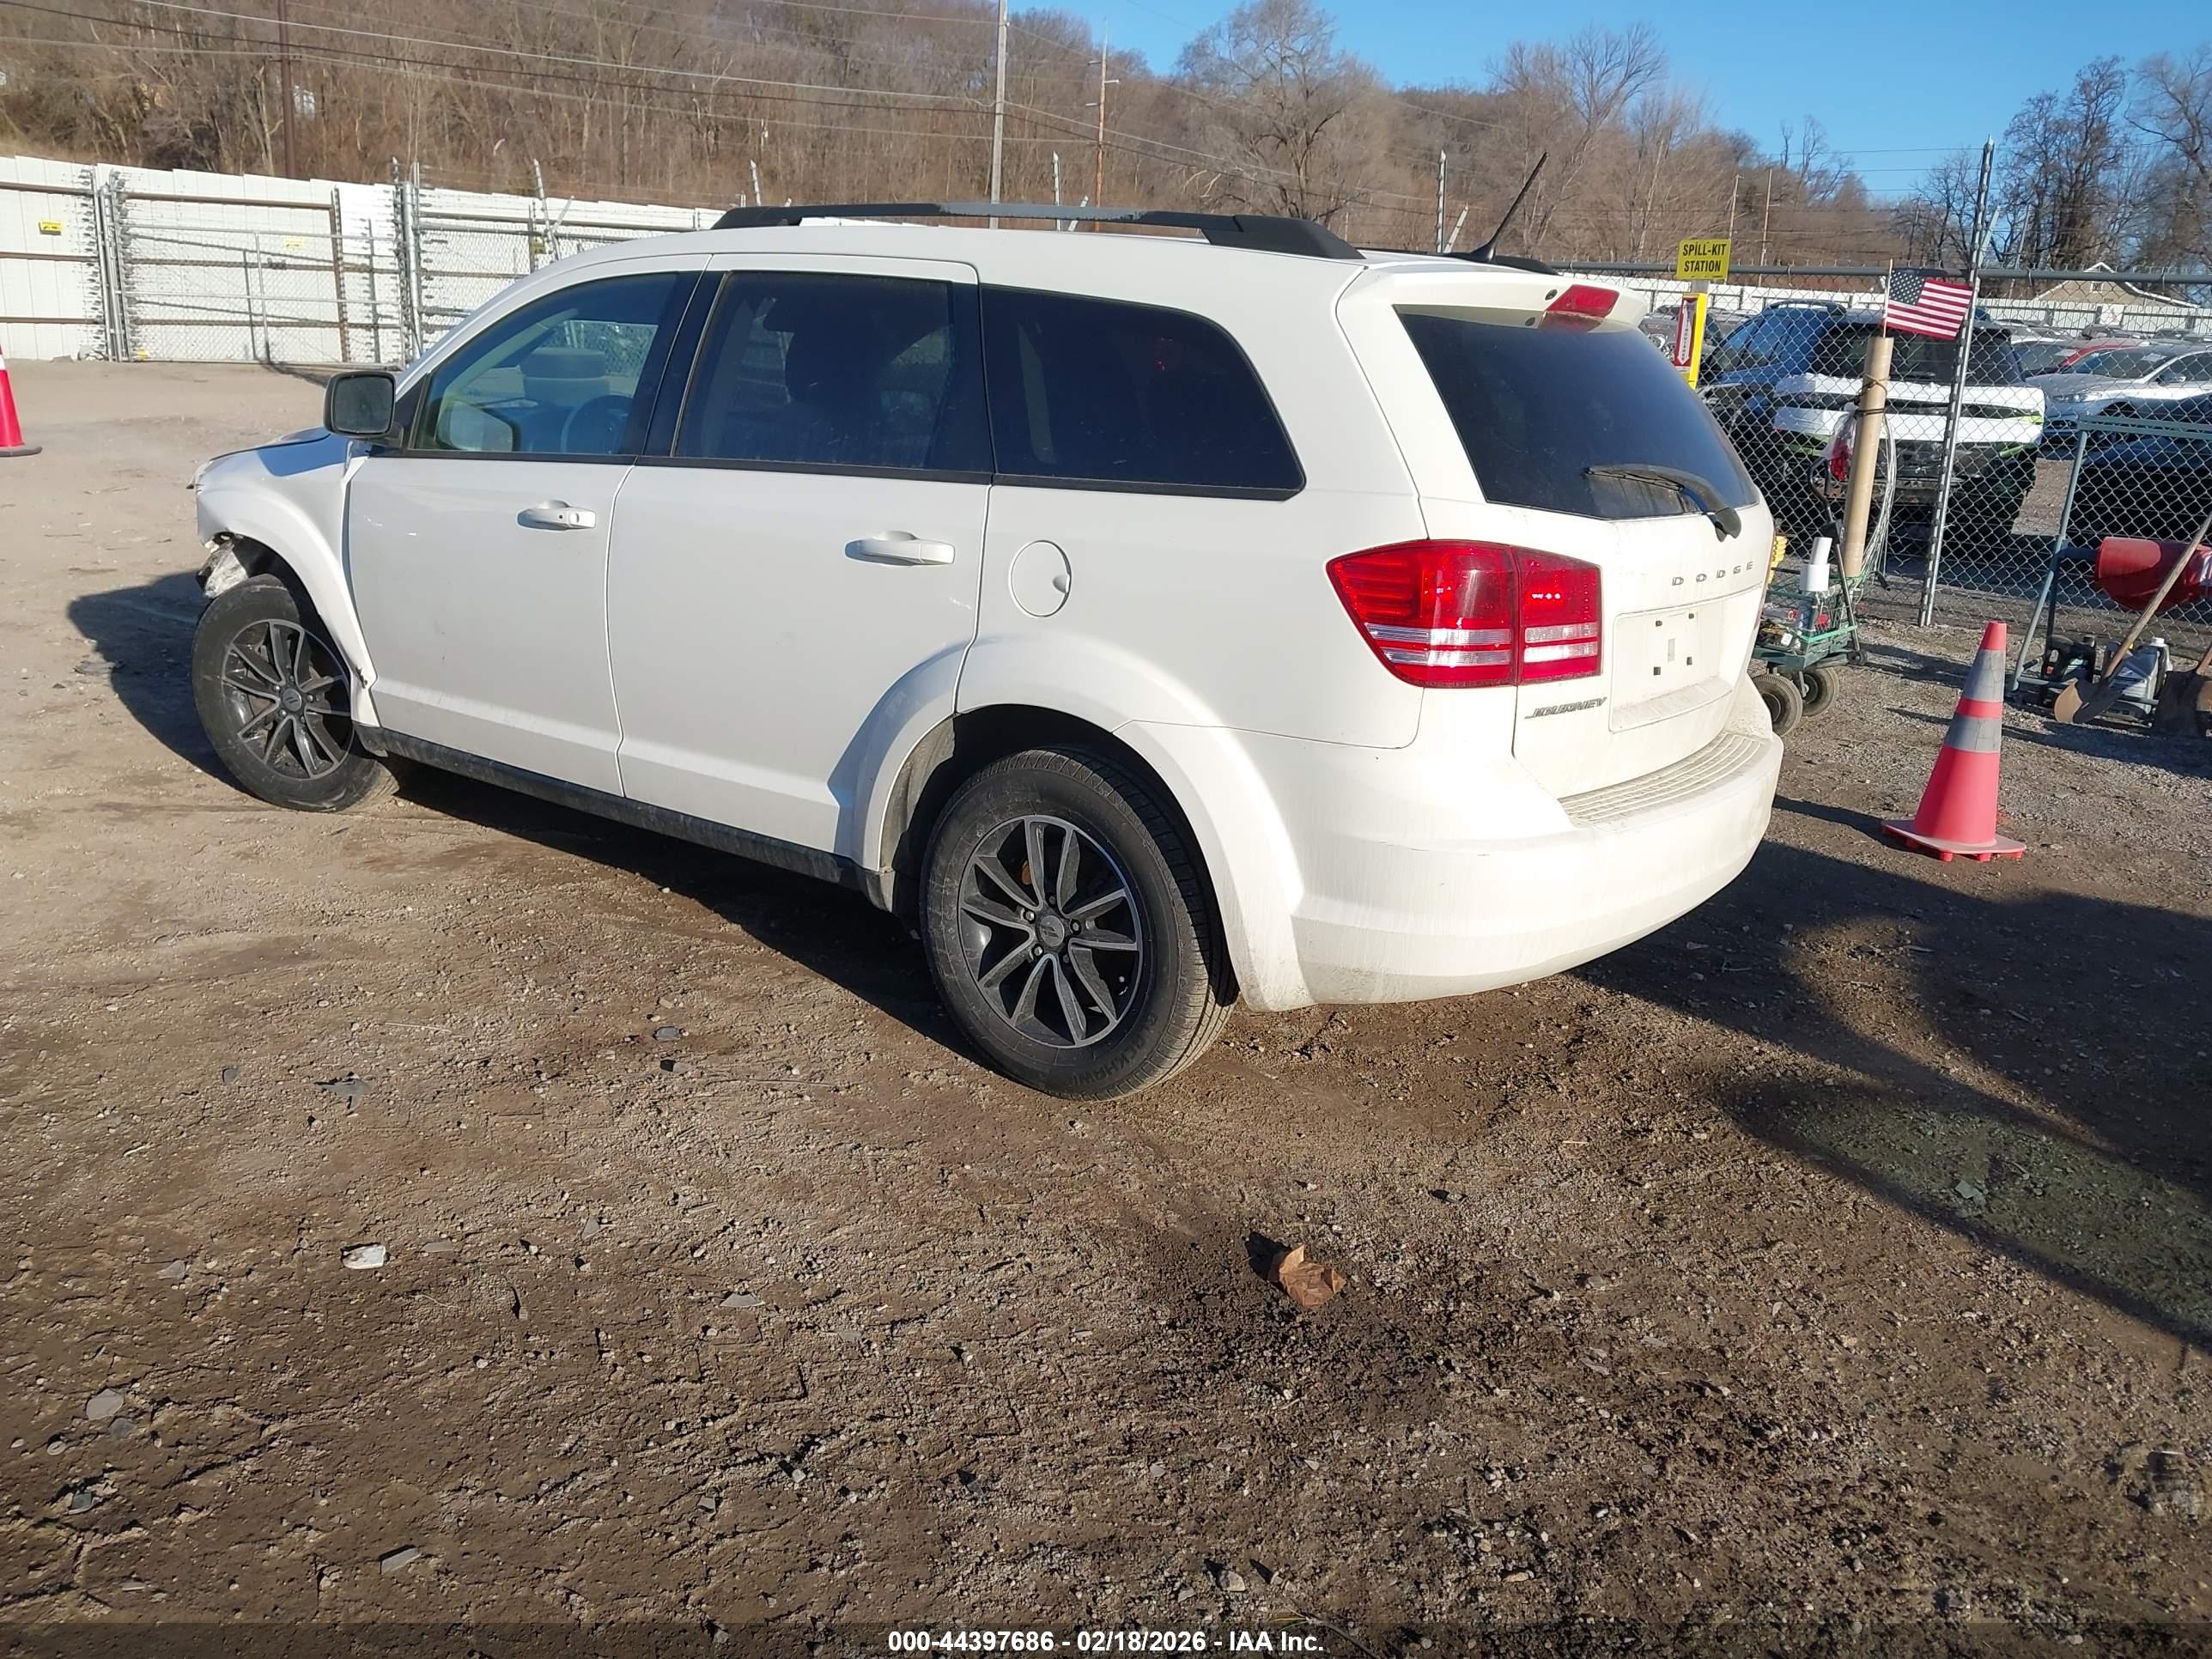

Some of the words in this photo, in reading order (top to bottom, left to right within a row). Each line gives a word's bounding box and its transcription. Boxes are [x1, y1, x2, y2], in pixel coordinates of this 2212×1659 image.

[1683, 244, 1727, 256] SPILL-KIT
[1684, 260, 1722, 272] STATION
[1672, 561, 1753, 586] DODGE
[1524, 696, 1607, 720] JOURNEY
